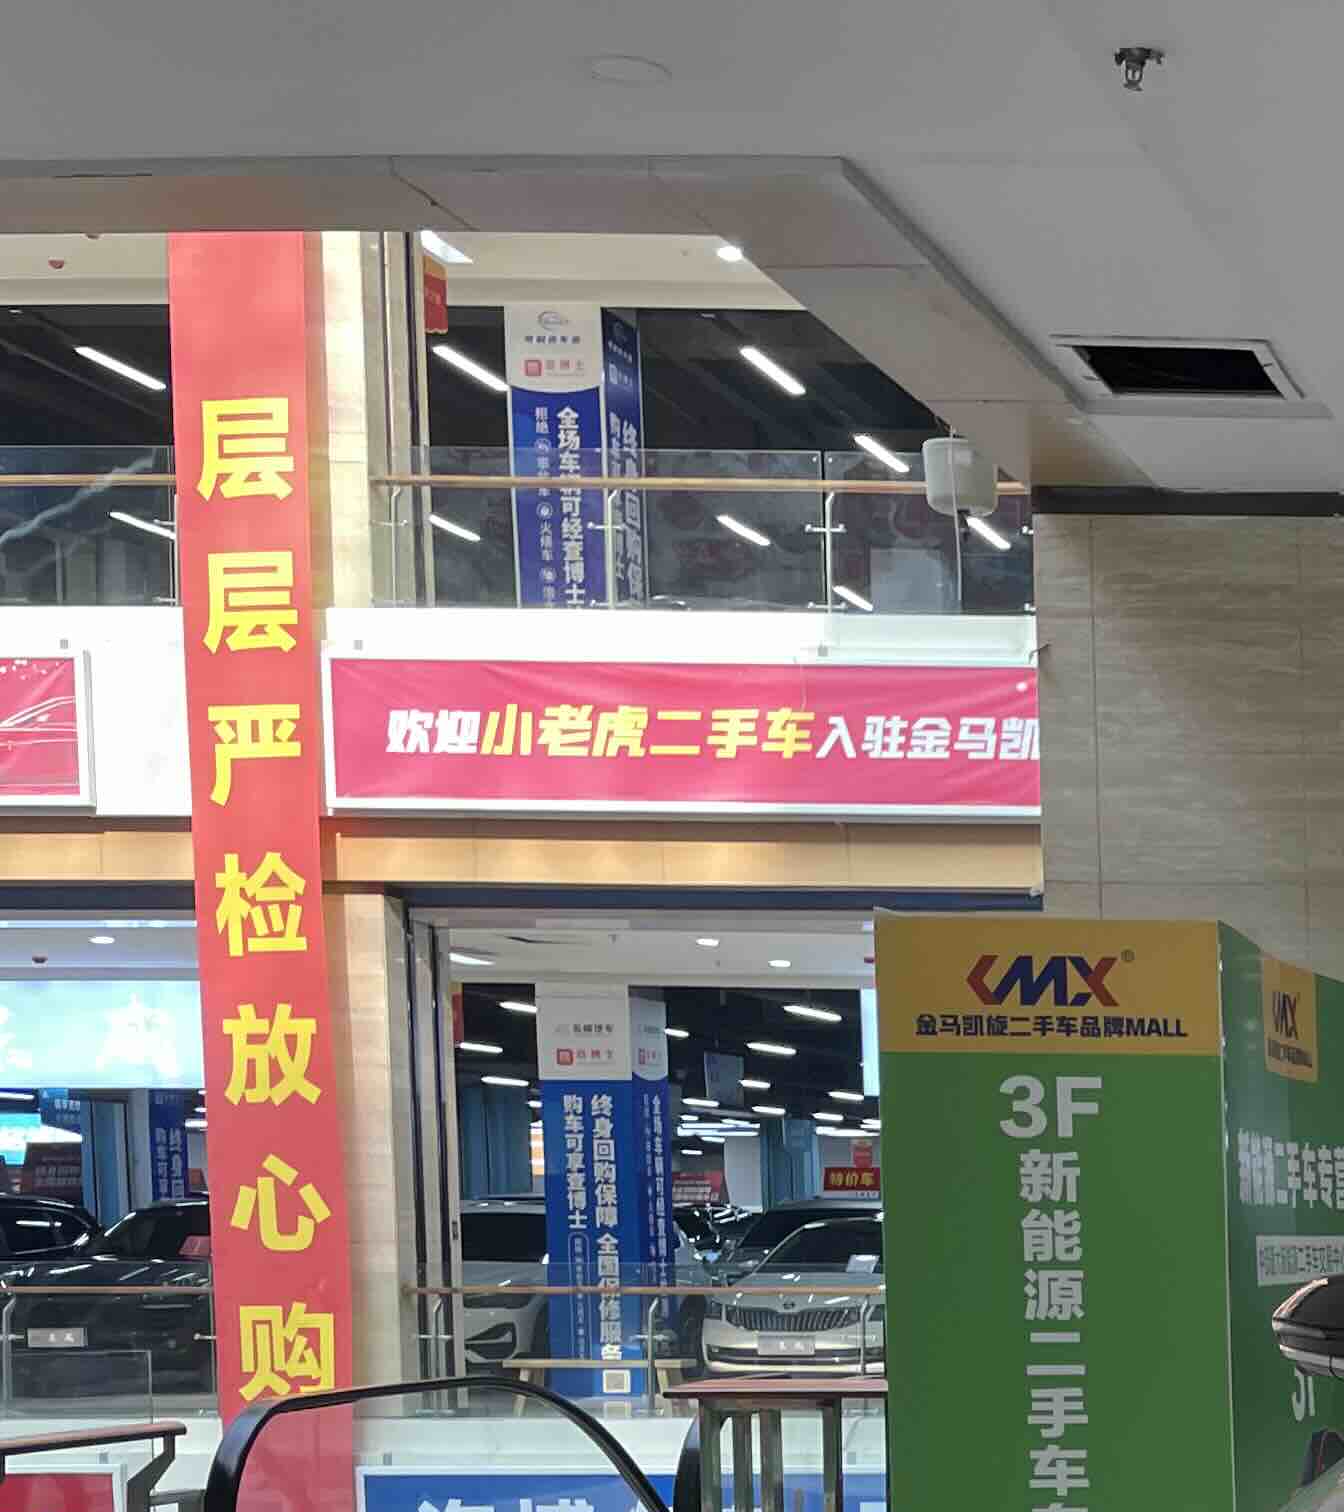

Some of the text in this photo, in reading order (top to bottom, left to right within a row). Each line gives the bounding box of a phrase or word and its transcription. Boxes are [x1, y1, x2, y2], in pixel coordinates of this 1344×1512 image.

[386, 703, 1041, 761] 欢迎小老虎二手车入驻金马凯
[197, 397, 334, 1400] 层层严检放心购
[915, 1013, 1188, 1039] 金马凯旋二手车品牌MALL
[999, 1075, 1102, 1138] 3F
